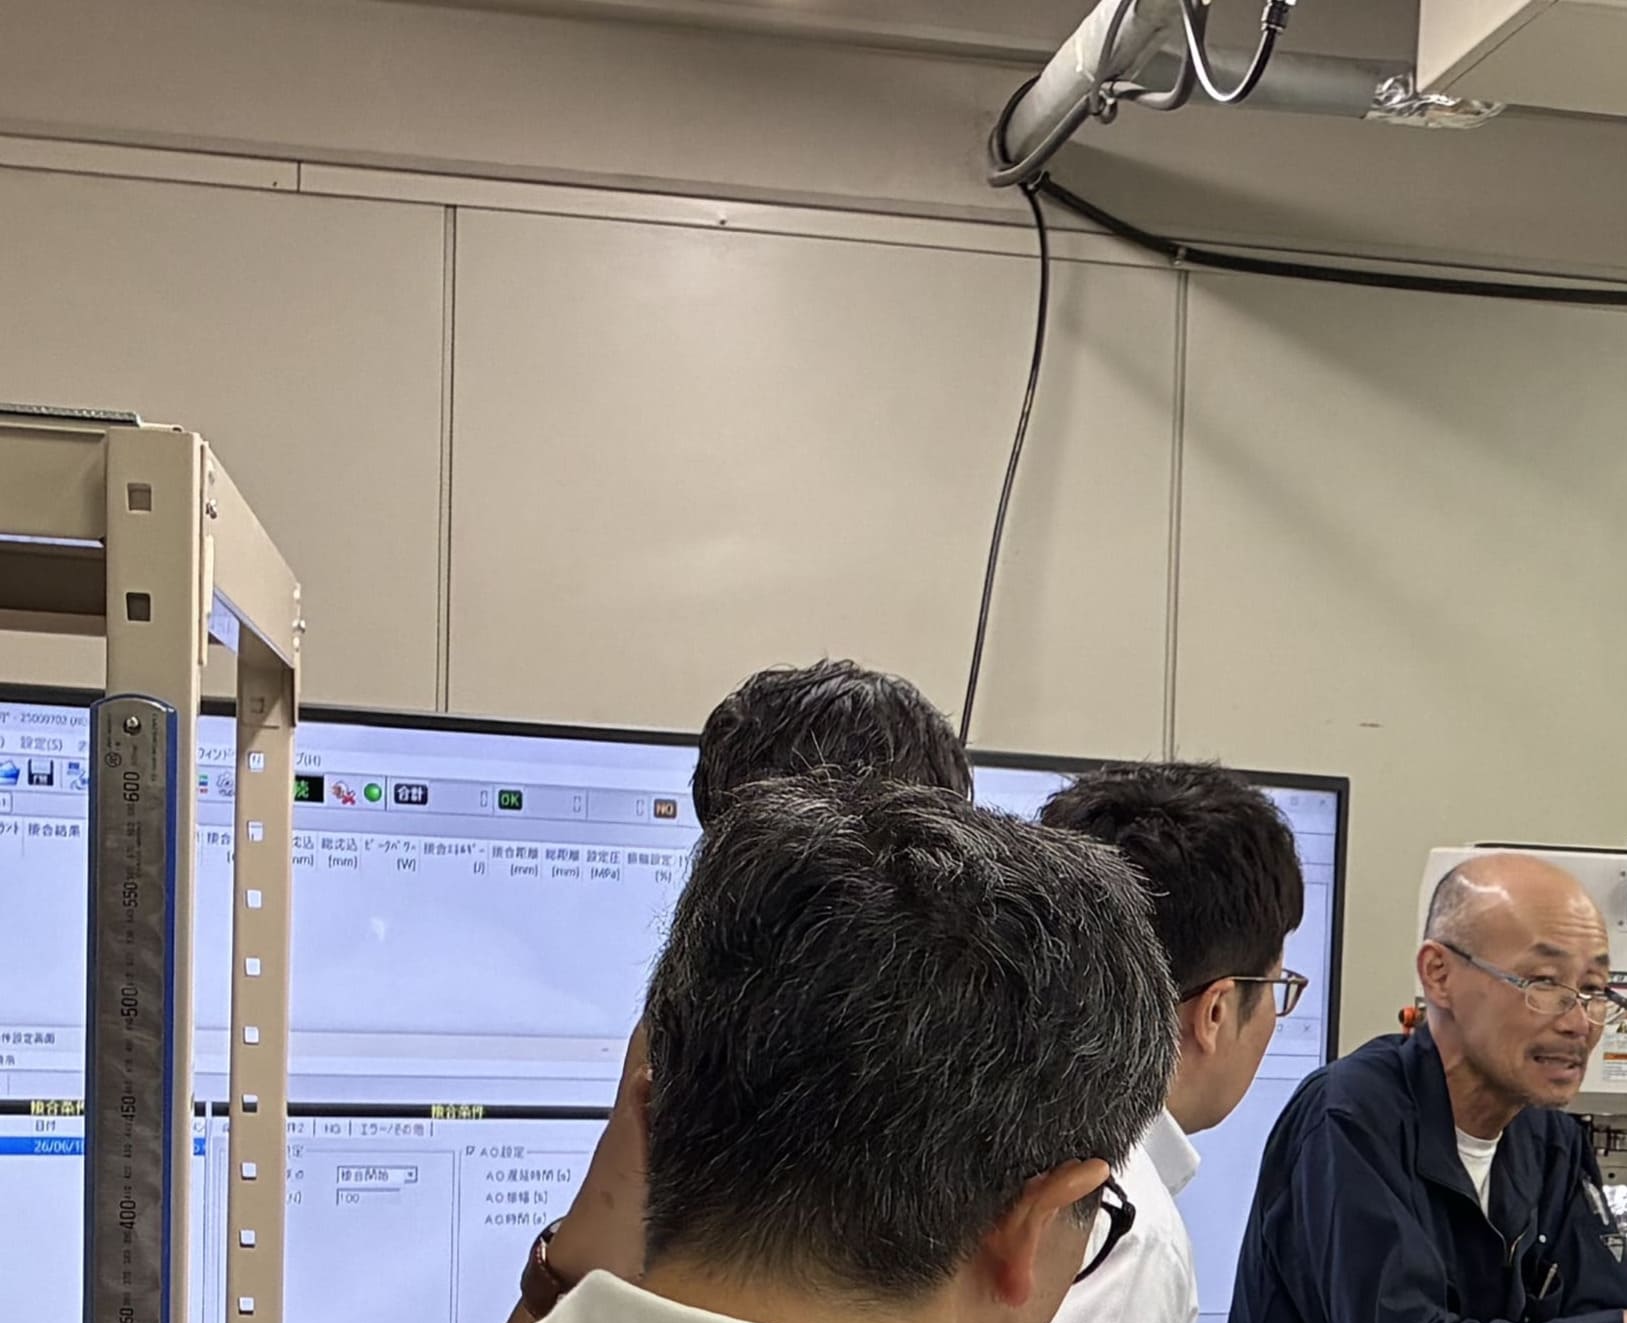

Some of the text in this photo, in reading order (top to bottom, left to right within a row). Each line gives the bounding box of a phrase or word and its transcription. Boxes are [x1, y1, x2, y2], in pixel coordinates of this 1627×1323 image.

[123, 771, 140, 802] 600
[397, 785, 424, 803] 合計
[500, 792, 521, 808] OK
[123, 882, 138, 908] 550
[121, 986, 138, 1018] 500
[121, 1095, 137, 1122] 450
[119, 1199, 137, 1231] 400
